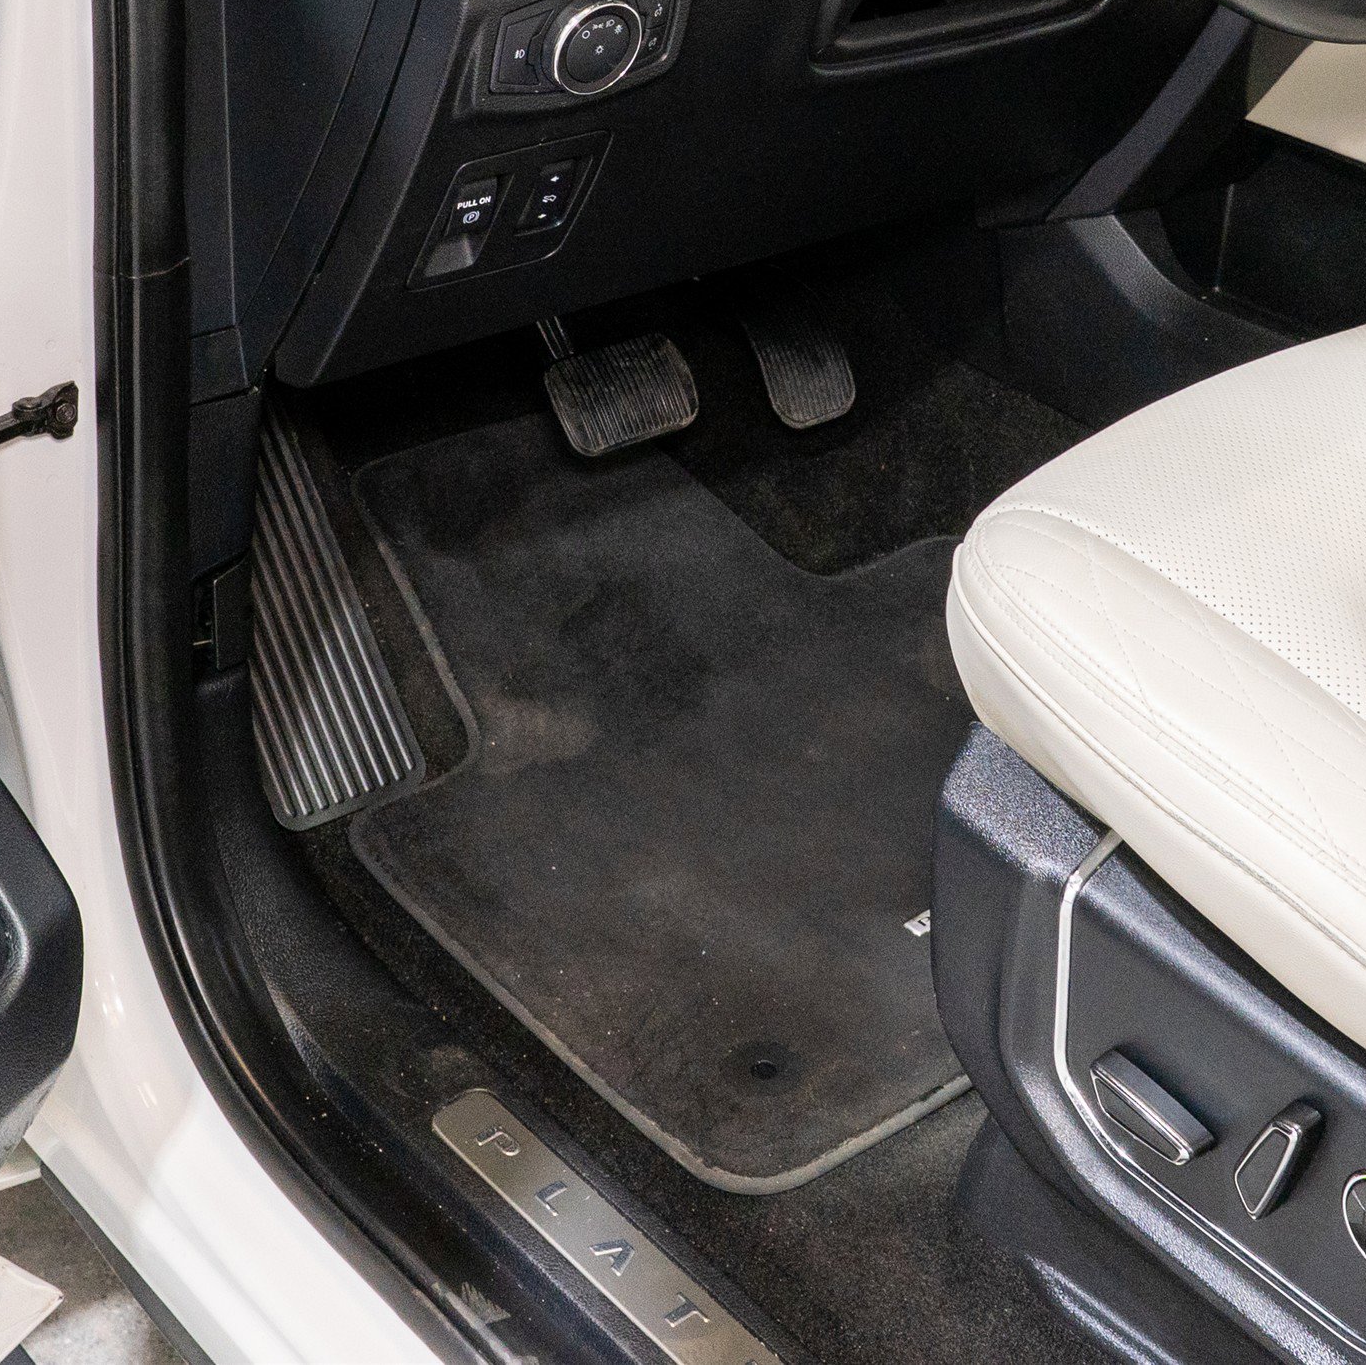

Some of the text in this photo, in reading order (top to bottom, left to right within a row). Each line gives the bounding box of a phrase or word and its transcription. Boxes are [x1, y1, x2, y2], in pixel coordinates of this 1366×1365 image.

[457, 195, 492, 210] PULL ON
[475, 1126, 711, 1328] PLAT
